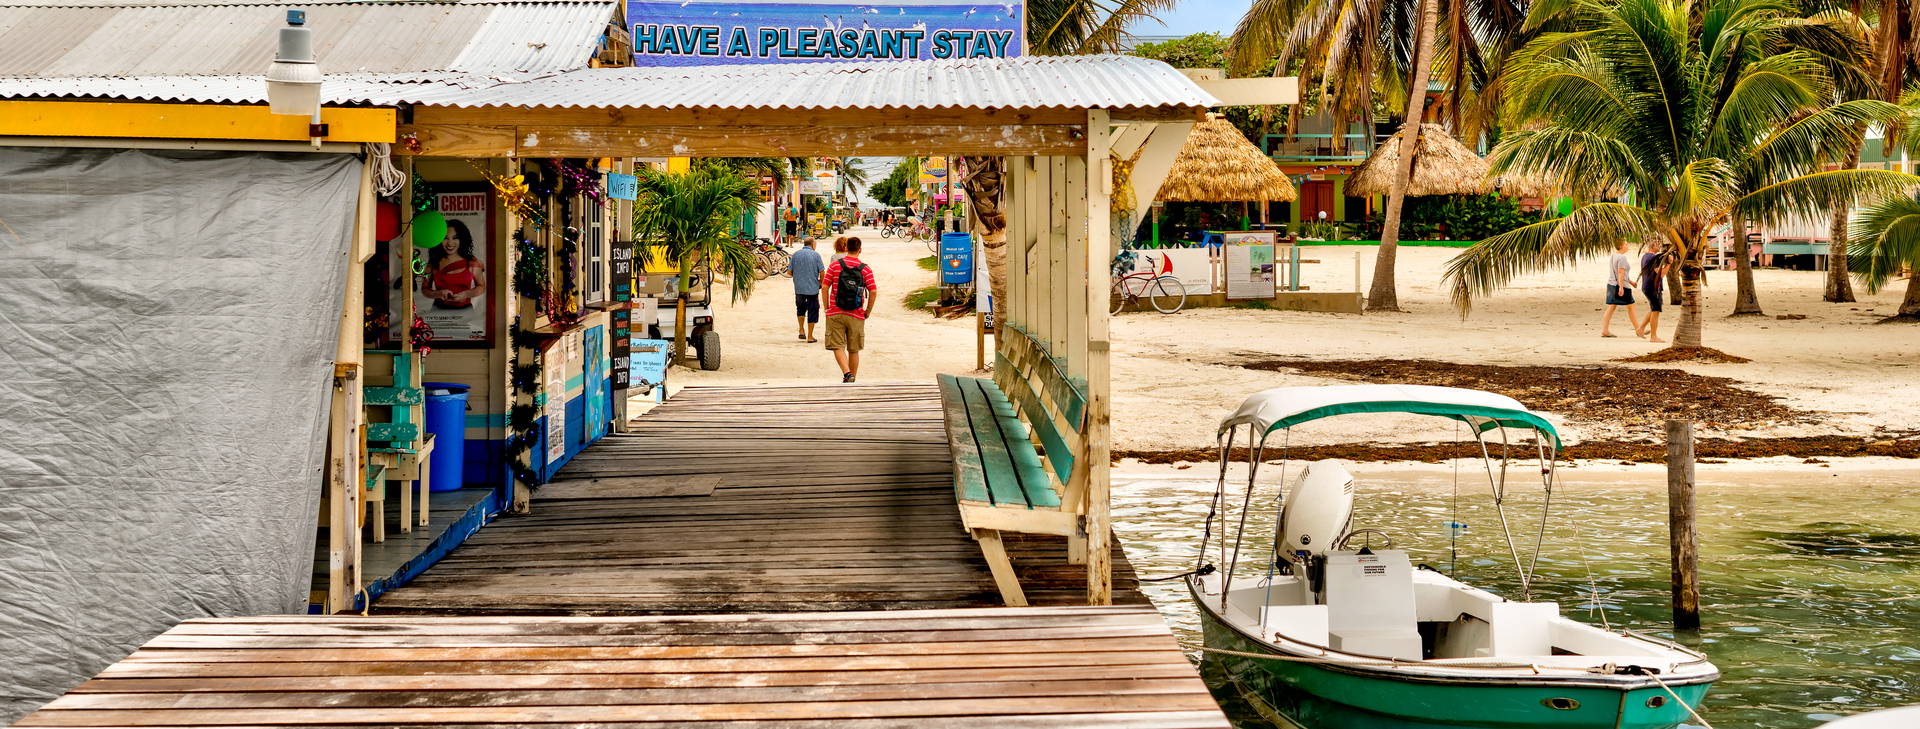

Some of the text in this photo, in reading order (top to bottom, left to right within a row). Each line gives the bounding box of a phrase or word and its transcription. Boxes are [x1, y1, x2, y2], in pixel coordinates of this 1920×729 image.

[634, 24, 1013, 59] HAVE A PLEASANT STAY
[441, 194, 485, 212] CREDIT!
[613, 247, 632, 260] ISLAND
[616, 262, 630, 274] INFO
[613, 356, 630, 370] ISLAND
[616, 371, 628, 384] INFO
